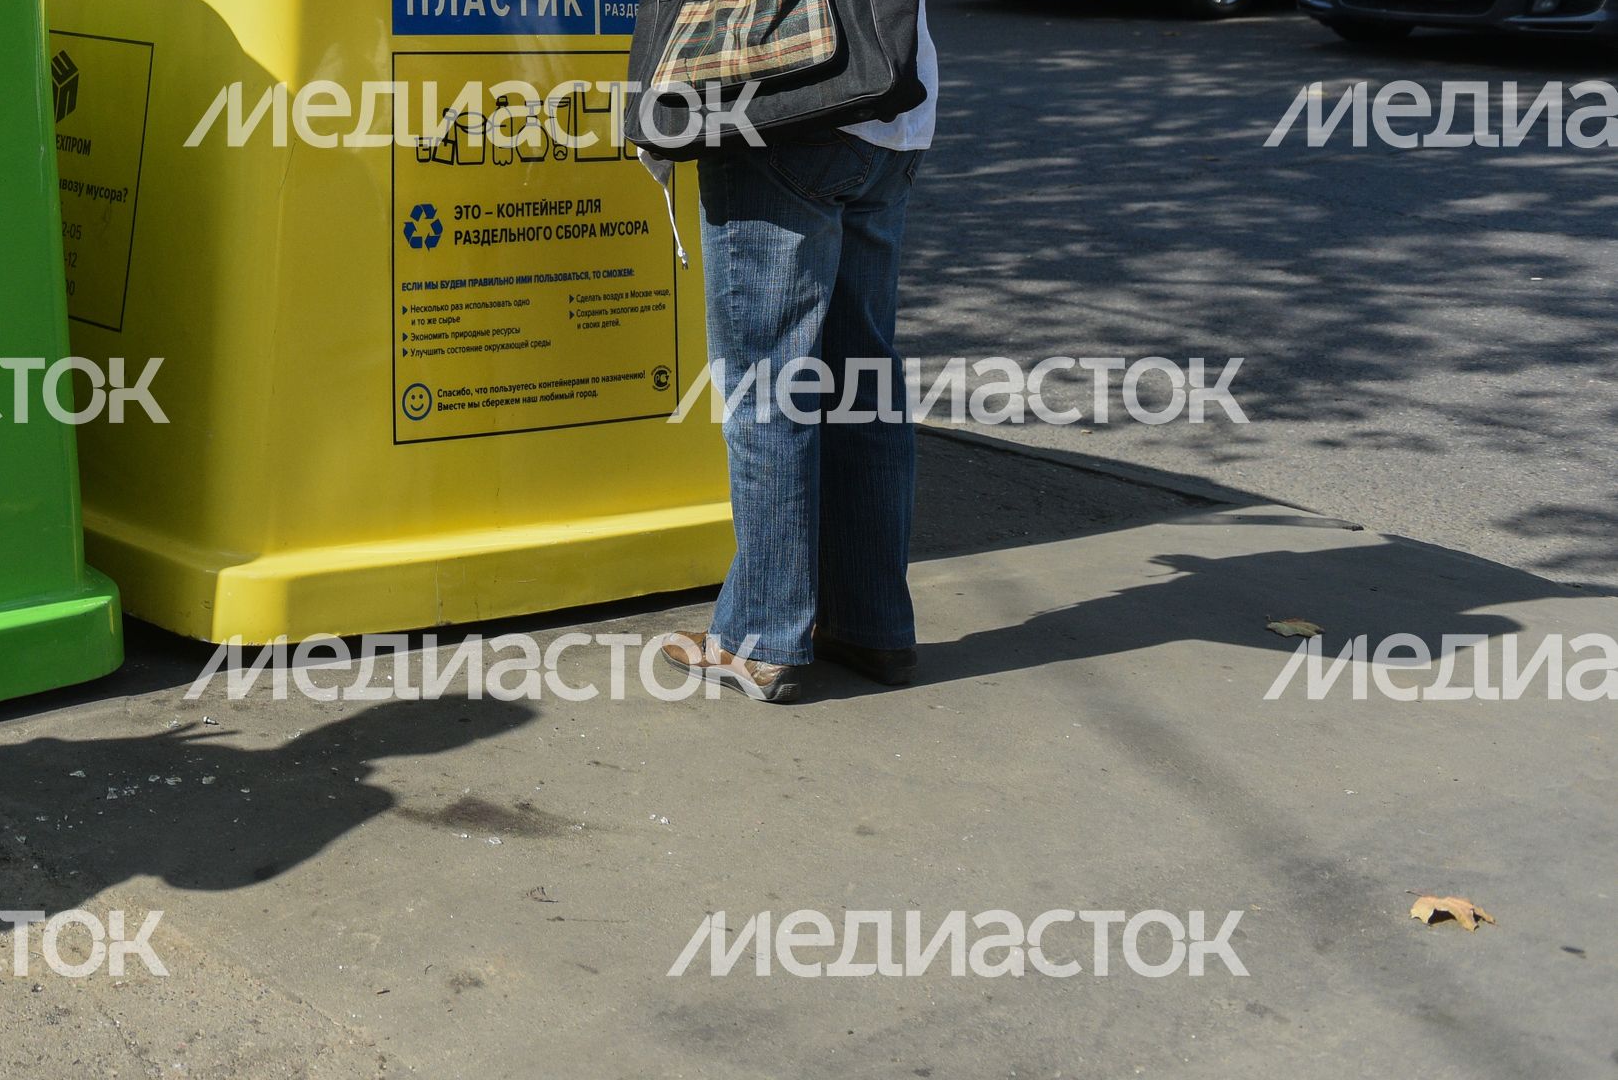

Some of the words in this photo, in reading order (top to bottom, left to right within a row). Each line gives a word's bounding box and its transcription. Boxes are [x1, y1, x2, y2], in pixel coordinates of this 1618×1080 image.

[86, 184, 128, 204] мусора?
[454, 204, 481, 221] ЭТО
[496, 198, 573, 219] КОНТЕЙНЕР
[576, 198, 601, 217] ДЛЯ
[454, 225, 552, 246] РАЗДЕЛЬНОГО
[555, 223, 597, 240] СБОРА
[600, 220, 649, 238] МУСОРА
[401, 281, 422, 292] ЕСЛИ
[424, 280, 438, 290] МЫ
[440, 278, 467, 291] БУДЕМ
[468, 276, 514, 288] ПРАВИЛЬНО
[515, 274, 532, 285] ИМИ
[592, 270, 601, 280] ТО
[410, 303, 449, 313] Несколько
[450, 302, 463, 312] раз
[464, 299, 512, 310] использовать
[513, 298, 530, 308] одно
[417, 318, 425, 326] то
[427, 317, 437, 325] же
[438, 315, 461, 326] сырье
[410, 331, 449, 342] Экономить
[451, 328, 490, 340] природные
[491, 326, 521, 337] ресурсы
[410, 348, 445, 359] Улучшить
[446, 344, 482, 355] состояние
[484, 340, 529, 353] окружающей
[530, 339, 551, 350] среды
[437, 386, 473, 398] Спасибо,
[475, 386, 488, 395] что
[489, 382, 537, 394] пользуетесь
[538, 377, 590, 390] контейнерами
[591, 375, 600, 385] по
[601, 370, 646, 384] назначению!
[437, 400, 466, 412] Вместе
[467, 400, 480, 409] мы
[481, 396, 520, 409] сбережем
[522, 395, 537, 404] наш
[539, 390, 575, 402] любимый
[575, 389, 598, 401] город.
